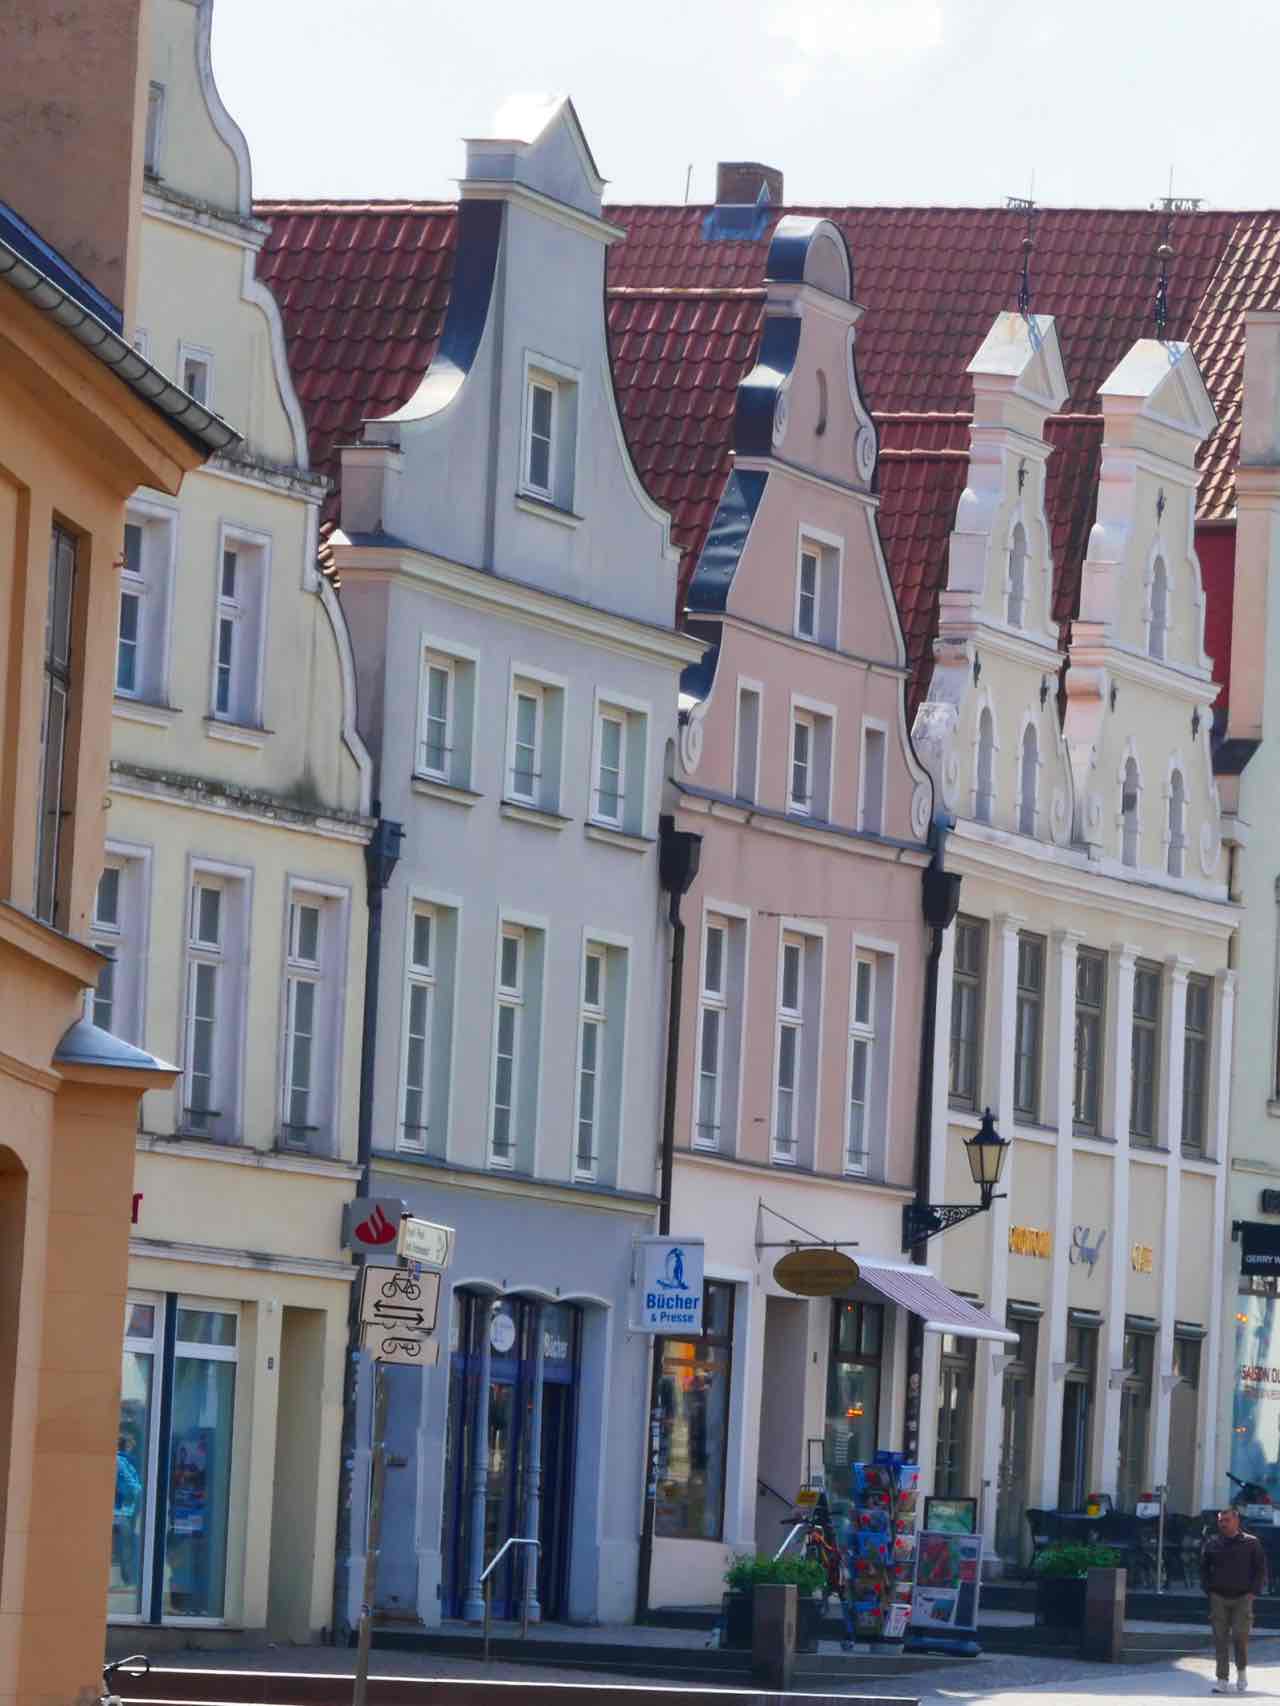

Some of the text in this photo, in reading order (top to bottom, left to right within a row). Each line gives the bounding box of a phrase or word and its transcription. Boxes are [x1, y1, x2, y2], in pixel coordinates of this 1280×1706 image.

[1246, 1253, 1273, 1265] GERRY
[646, 1292, 700, 1310] Bücher
[650, 1311, 695, 1323] & Presse
